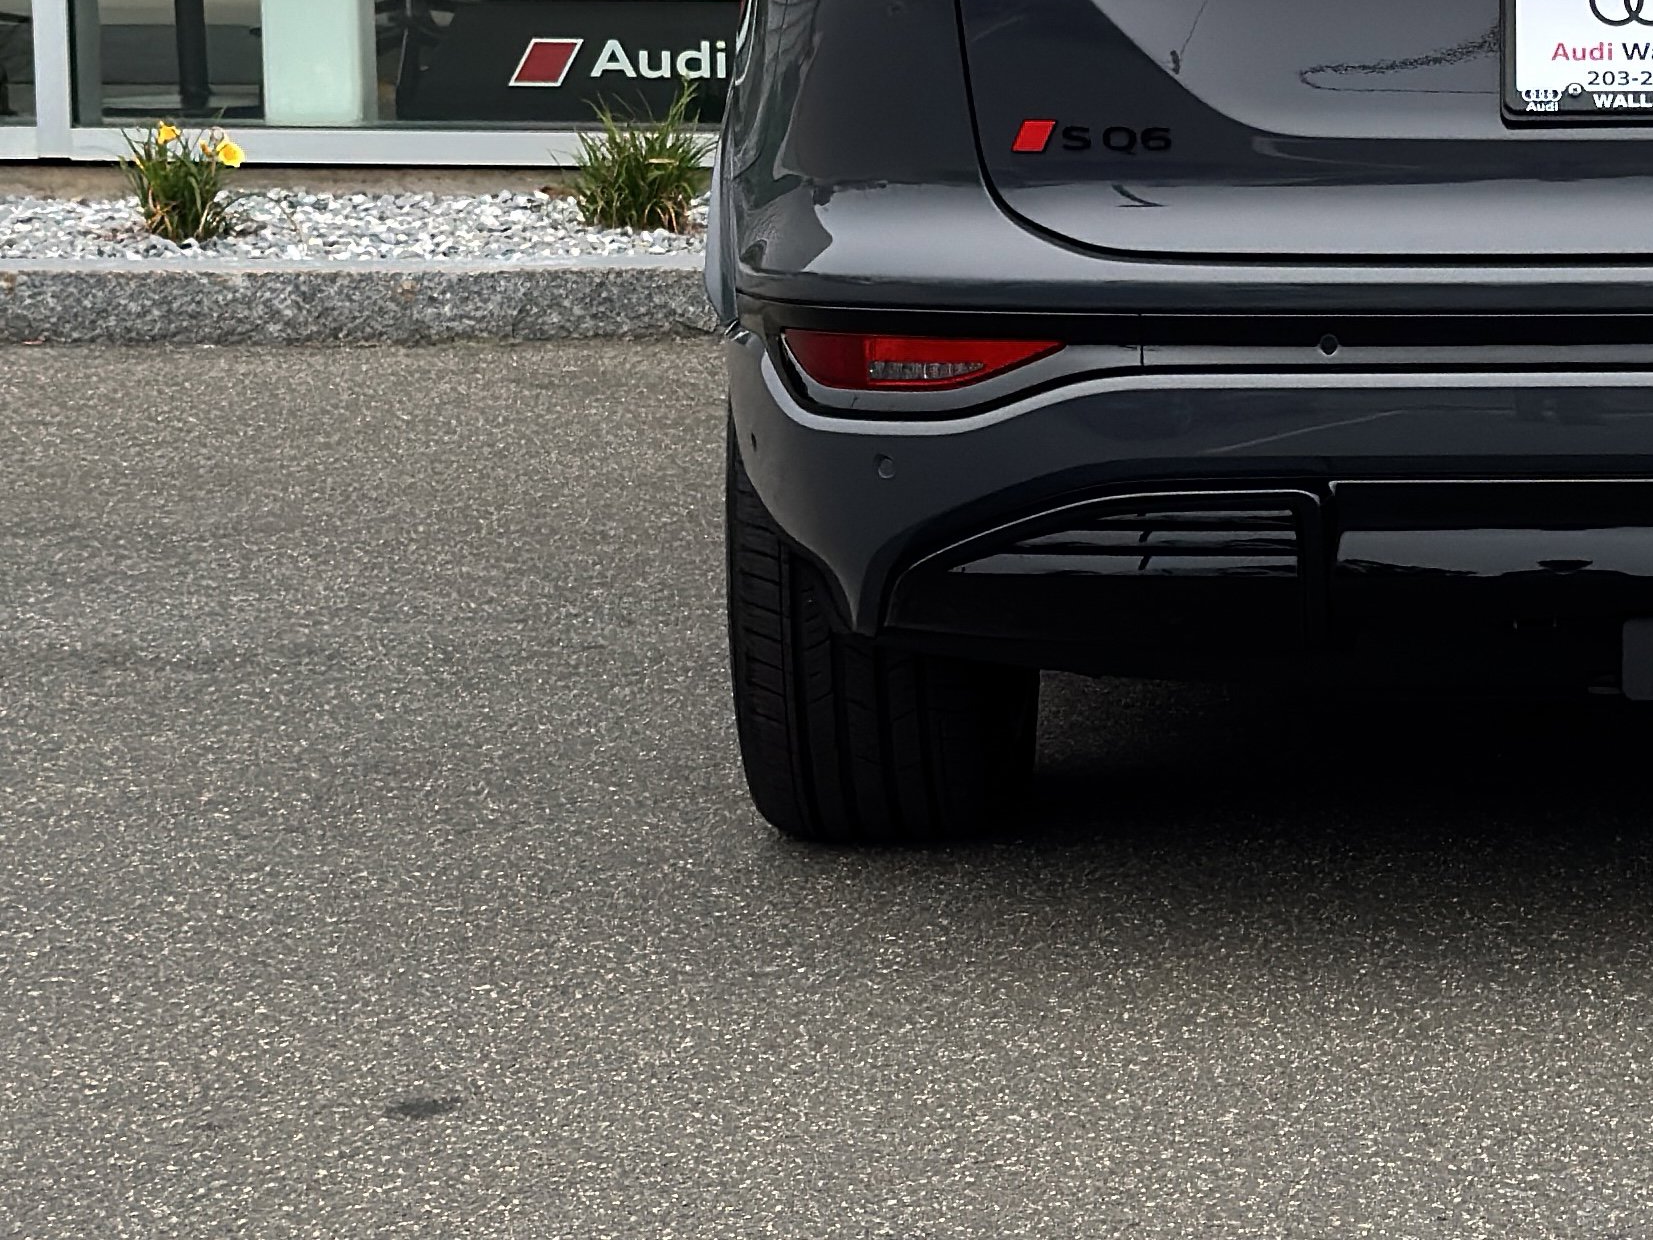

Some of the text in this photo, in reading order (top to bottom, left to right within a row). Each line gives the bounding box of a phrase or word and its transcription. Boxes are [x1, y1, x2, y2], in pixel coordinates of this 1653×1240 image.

[590, 39, 726, 78] Audi
[1551, 41, 1614, 61] Audi
[1525, 101, 1559, 112] Audi
